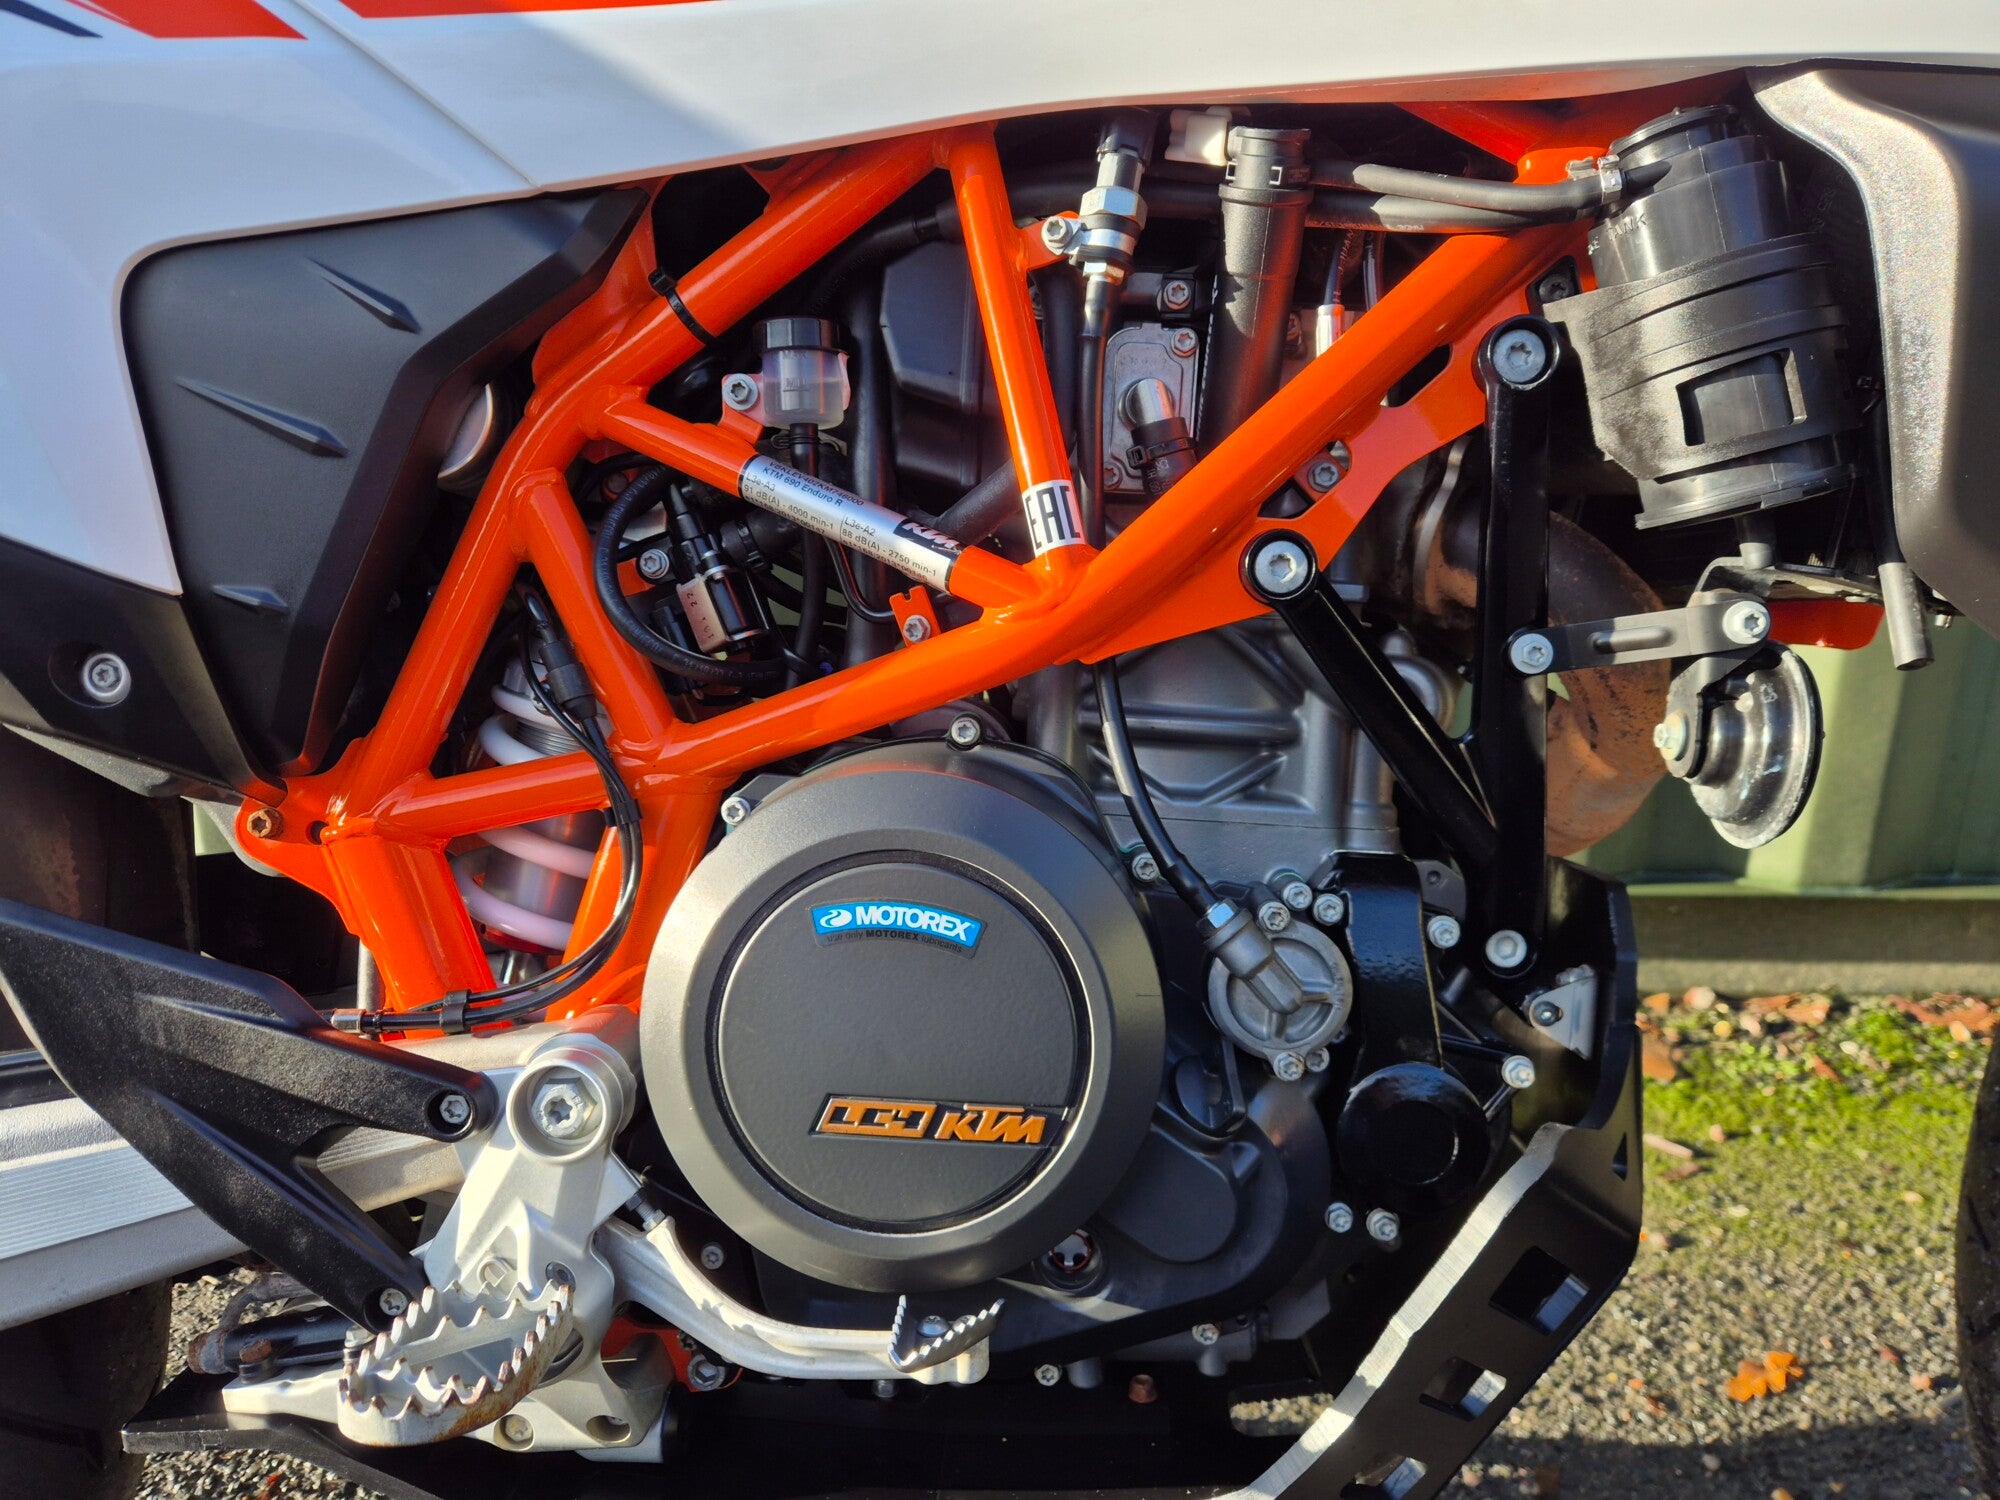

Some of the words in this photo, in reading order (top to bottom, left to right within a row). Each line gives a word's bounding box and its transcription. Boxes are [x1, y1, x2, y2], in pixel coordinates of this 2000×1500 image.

[745, 472, 776, 491] L3e-A3
[763, 466, 784, 481] KTM
[784, 477, 801, 488] 690
[801, 484, 833, 503] Enduro
[835, 498, 843, 507] R
[743, 484, 754, 494] 91
[756, 491, 780, 507] dB(A)
[788, 504, 809, 519] 4000
[810, 514, 834, 530] min-1
[844, 515, 877, 537] L3e-A2
[854, 534, 880, 552] dB(A)
[888, 550, 911, 565] 2750
[912, 561, 937, 577] min-1
[845, 930, 864, 941] only
[865, 929, 920, 942] MOTOREX
[921, 933, 963, 953] lubricants
[855, 905, 971, 942] MOTOREX
[934, 1103, 1047, 1144] KTM
